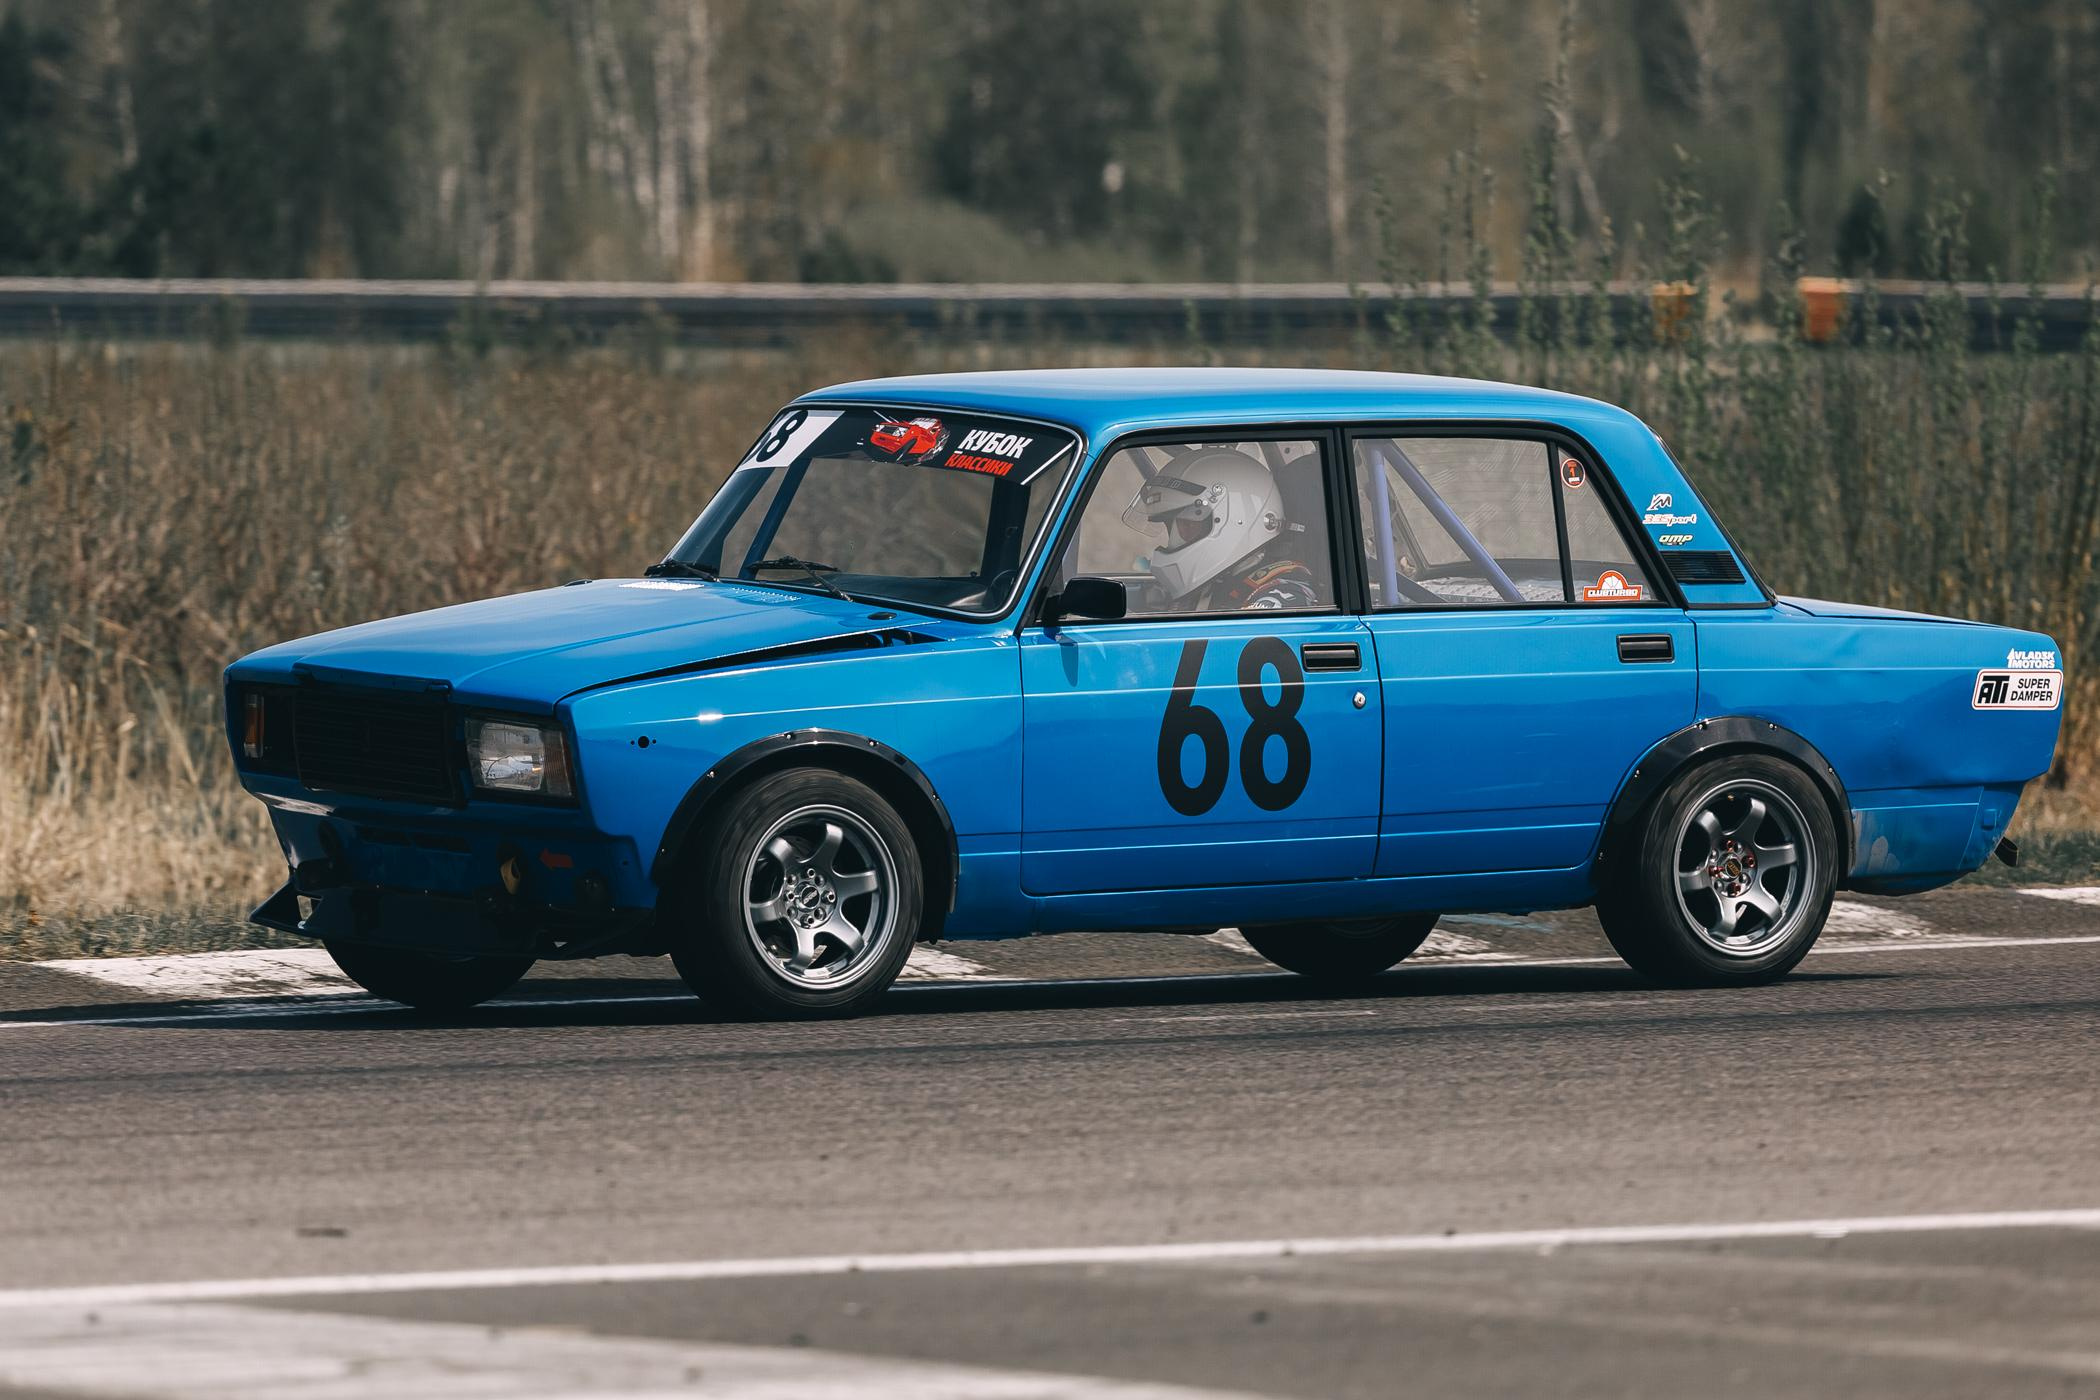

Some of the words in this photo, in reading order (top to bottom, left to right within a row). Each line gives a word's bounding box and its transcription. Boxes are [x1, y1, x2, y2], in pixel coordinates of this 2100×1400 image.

[957, 429, 1034, 459] КУБОК
[944, 452, 1015, 477] КЛАССИКИ
[2012, 659, 2055, 669] MOTORS
[1977, 675, 2010, 704] ATI
[2010, 690, 2053, 701] DAMPER
[2017, 678, 2051, 689] SUPER
[1157, 636, 1312, 817] 68
